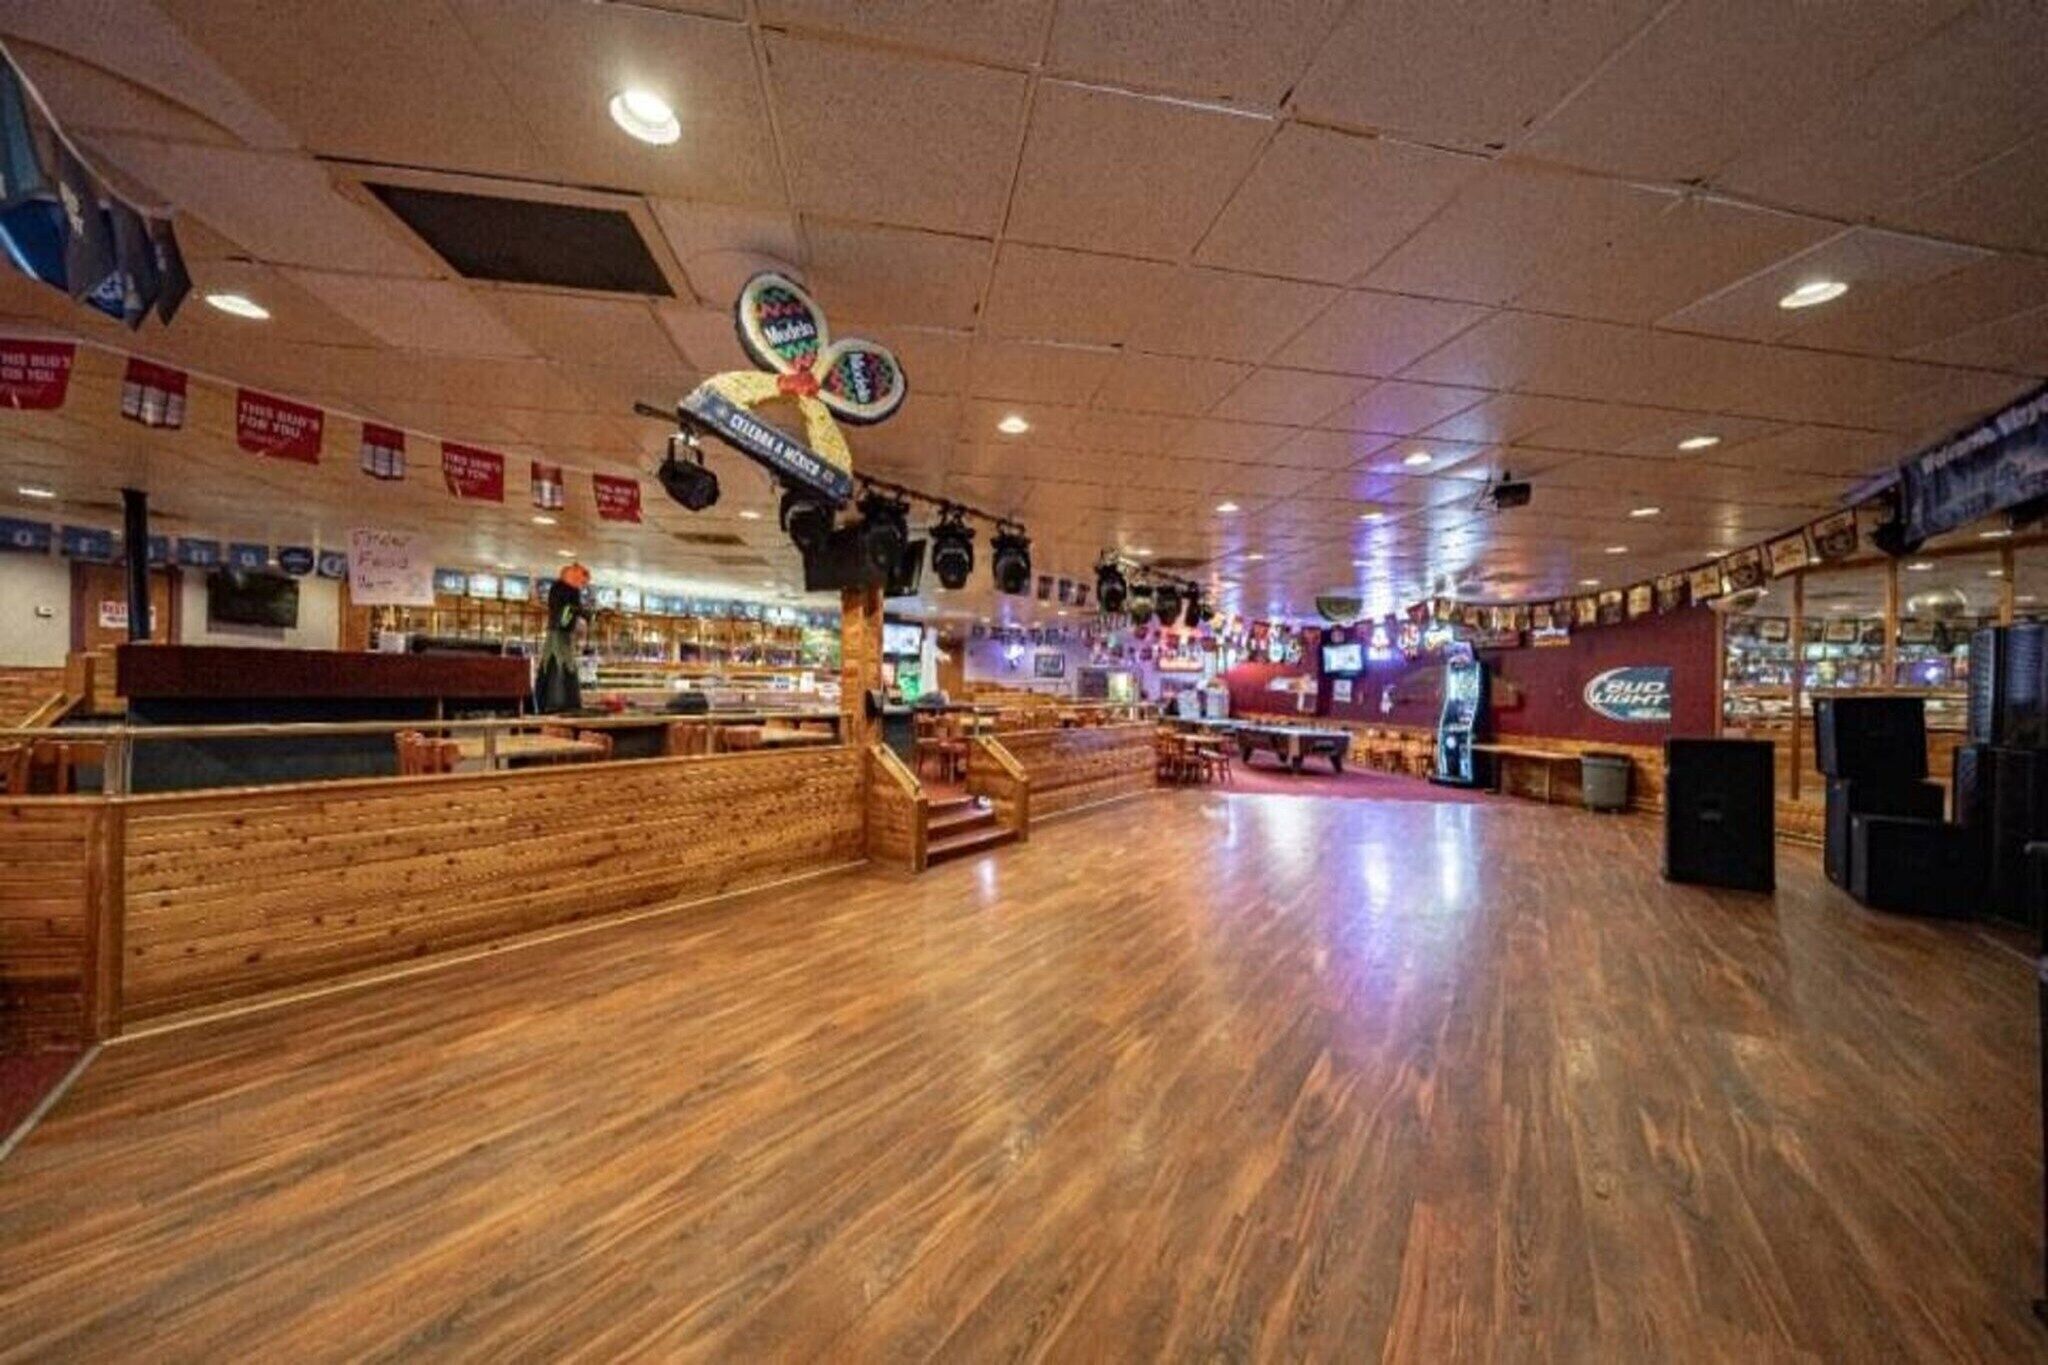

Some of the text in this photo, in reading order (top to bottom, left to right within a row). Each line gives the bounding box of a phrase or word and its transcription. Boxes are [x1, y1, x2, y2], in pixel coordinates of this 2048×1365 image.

[0, 352, 27, 367] HIS
[0, 368, 23, 380] OR
[241, 401, 274, 419] THIS
[239, 413, 301, 438] FOR YOU
[729, 413, 775, 449] CELEBRA
[1604, 680, 1666, 694] BUD
[1591, 692, 1671, 705] LIGHT
